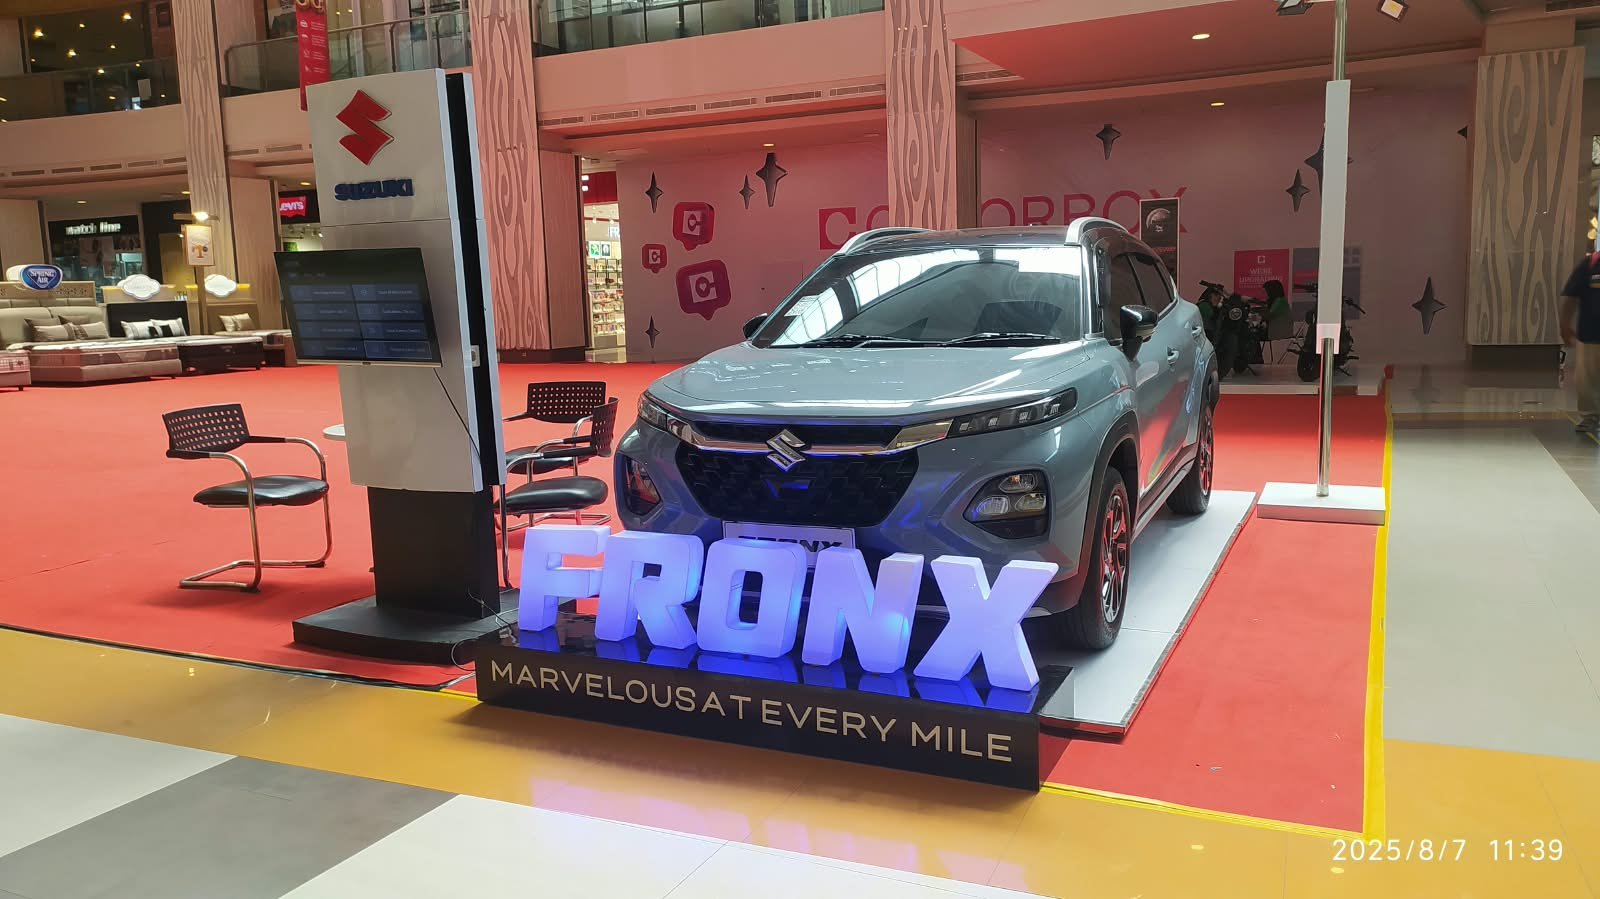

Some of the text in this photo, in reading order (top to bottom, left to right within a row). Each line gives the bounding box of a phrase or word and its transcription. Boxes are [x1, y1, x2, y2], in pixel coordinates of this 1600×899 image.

[334, 179, 414, 201] SUZUKI
[65, 221, 121, 236] watch line
[518, 524, 1059, 692] FRONX
[761, 699, 897, 743] EVERY
[911, 721, 1013, 763] MILE
